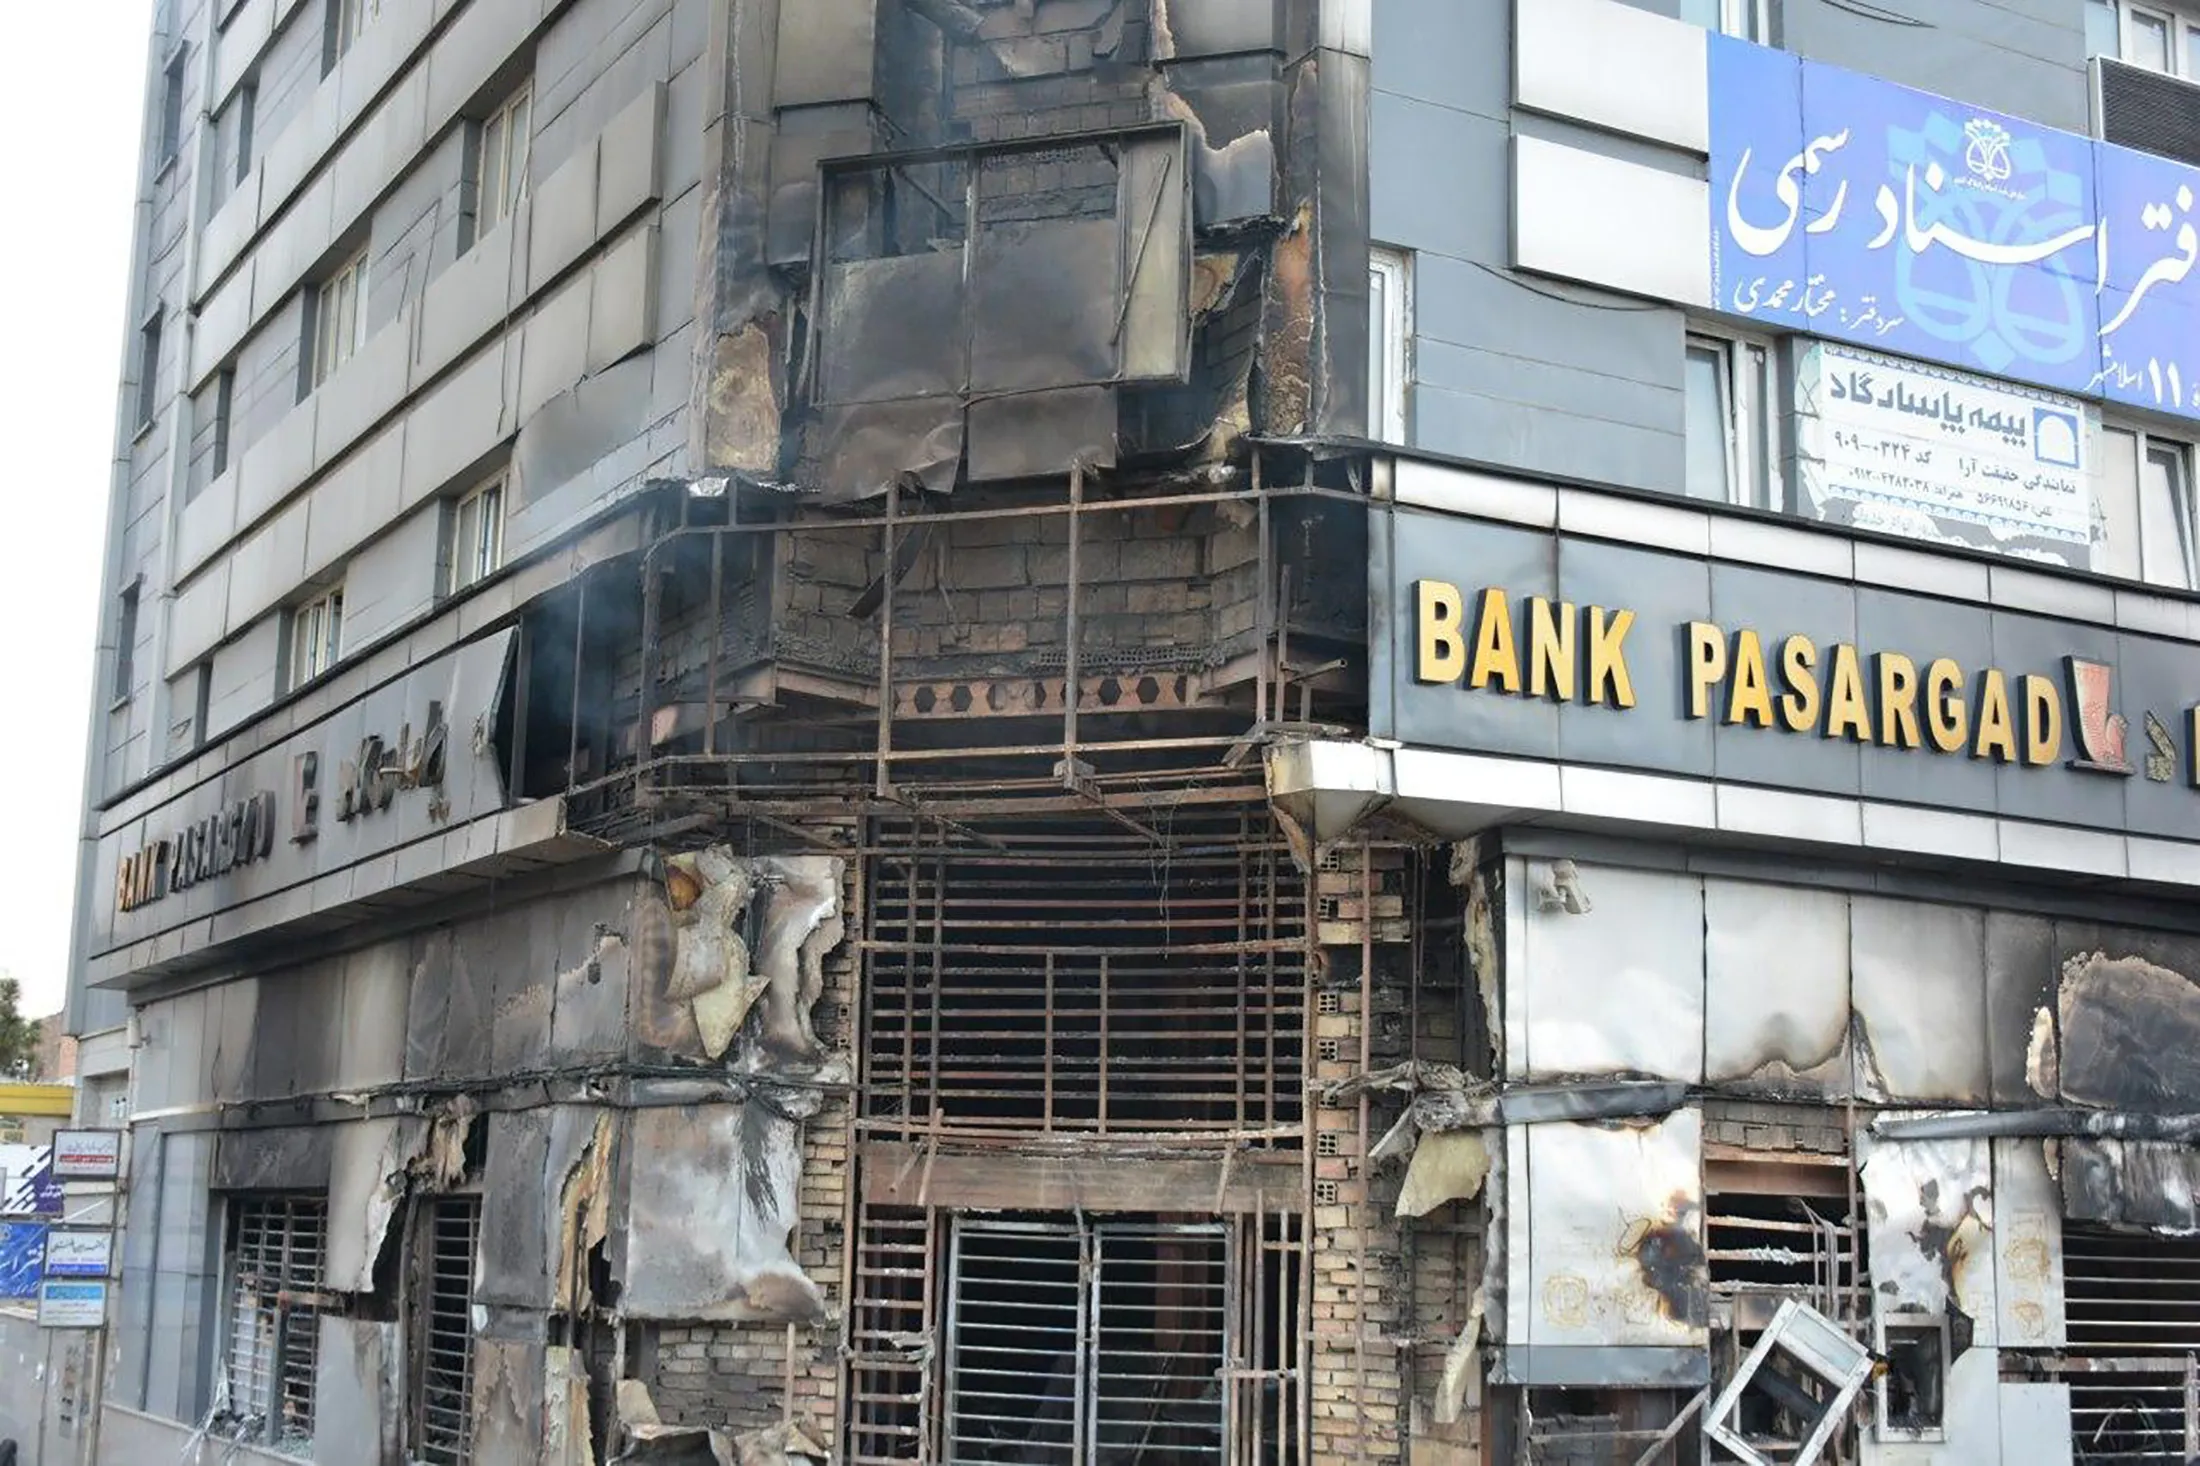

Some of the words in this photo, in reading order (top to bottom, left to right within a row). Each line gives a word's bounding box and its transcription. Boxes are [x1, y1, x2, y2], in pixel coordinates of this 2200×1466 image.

[1727, 127, 1850, 257] رسمی
[1865, 161, 2108, 296] اسناد
[1733, 277, 1795, 314] محمدی
[1789, 273, 1837, 318] مختار
[2097, 184, 2197, 336] فتر
[1830, 370, 1966, 434] پاسارگاد
[1968, 406, 2027, 449] بیمه
[1413, 579, 1637, 710] BANK
[1683, 620, 2062, 766] PASARGAD
